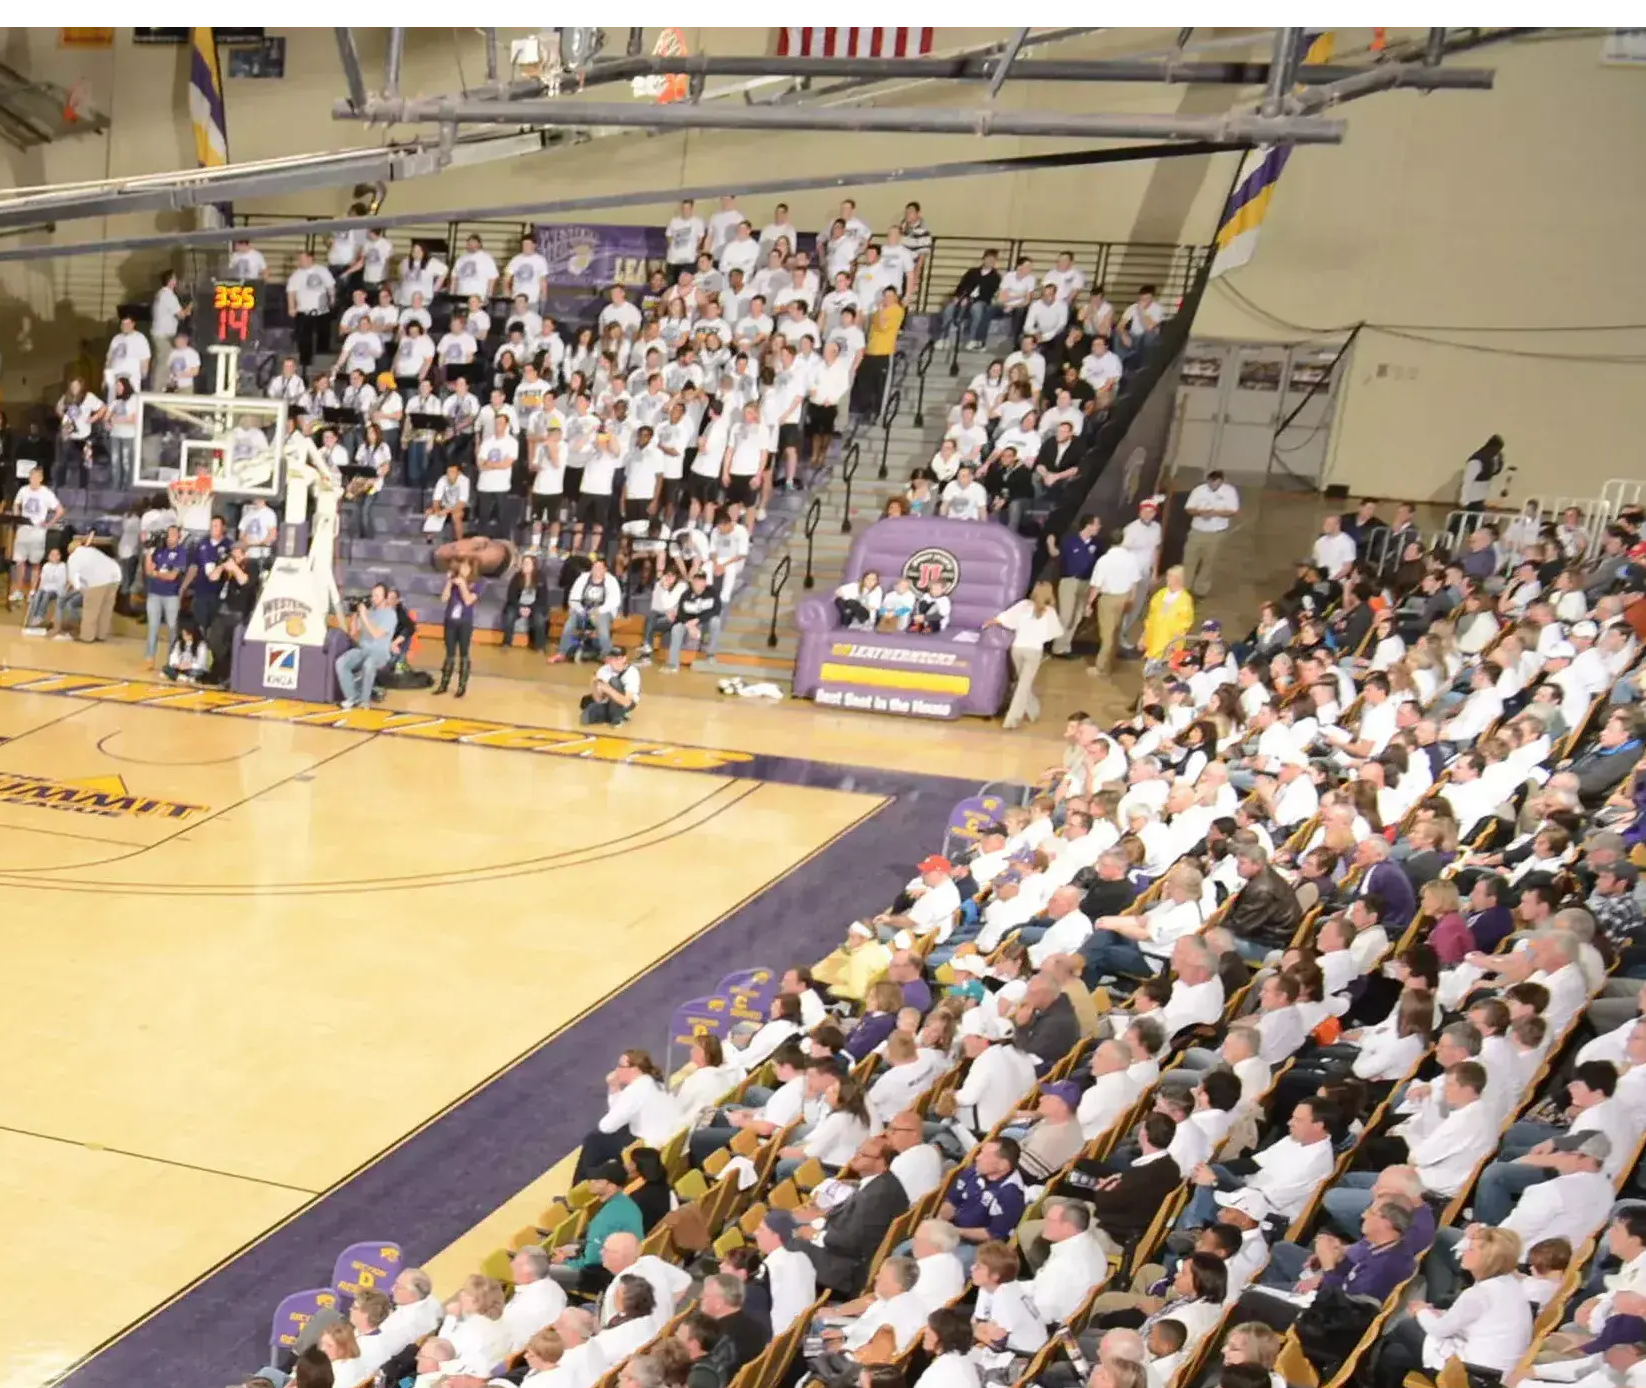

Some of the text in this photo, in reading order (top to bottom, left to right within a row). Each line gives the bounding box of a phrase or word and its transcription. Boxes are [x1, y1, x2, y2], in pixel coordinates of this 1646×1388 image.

[218, 308, 248, 341] 14
[262, 597, 313, 616] WESTERN
[357, 1270, 375, 1288] D
